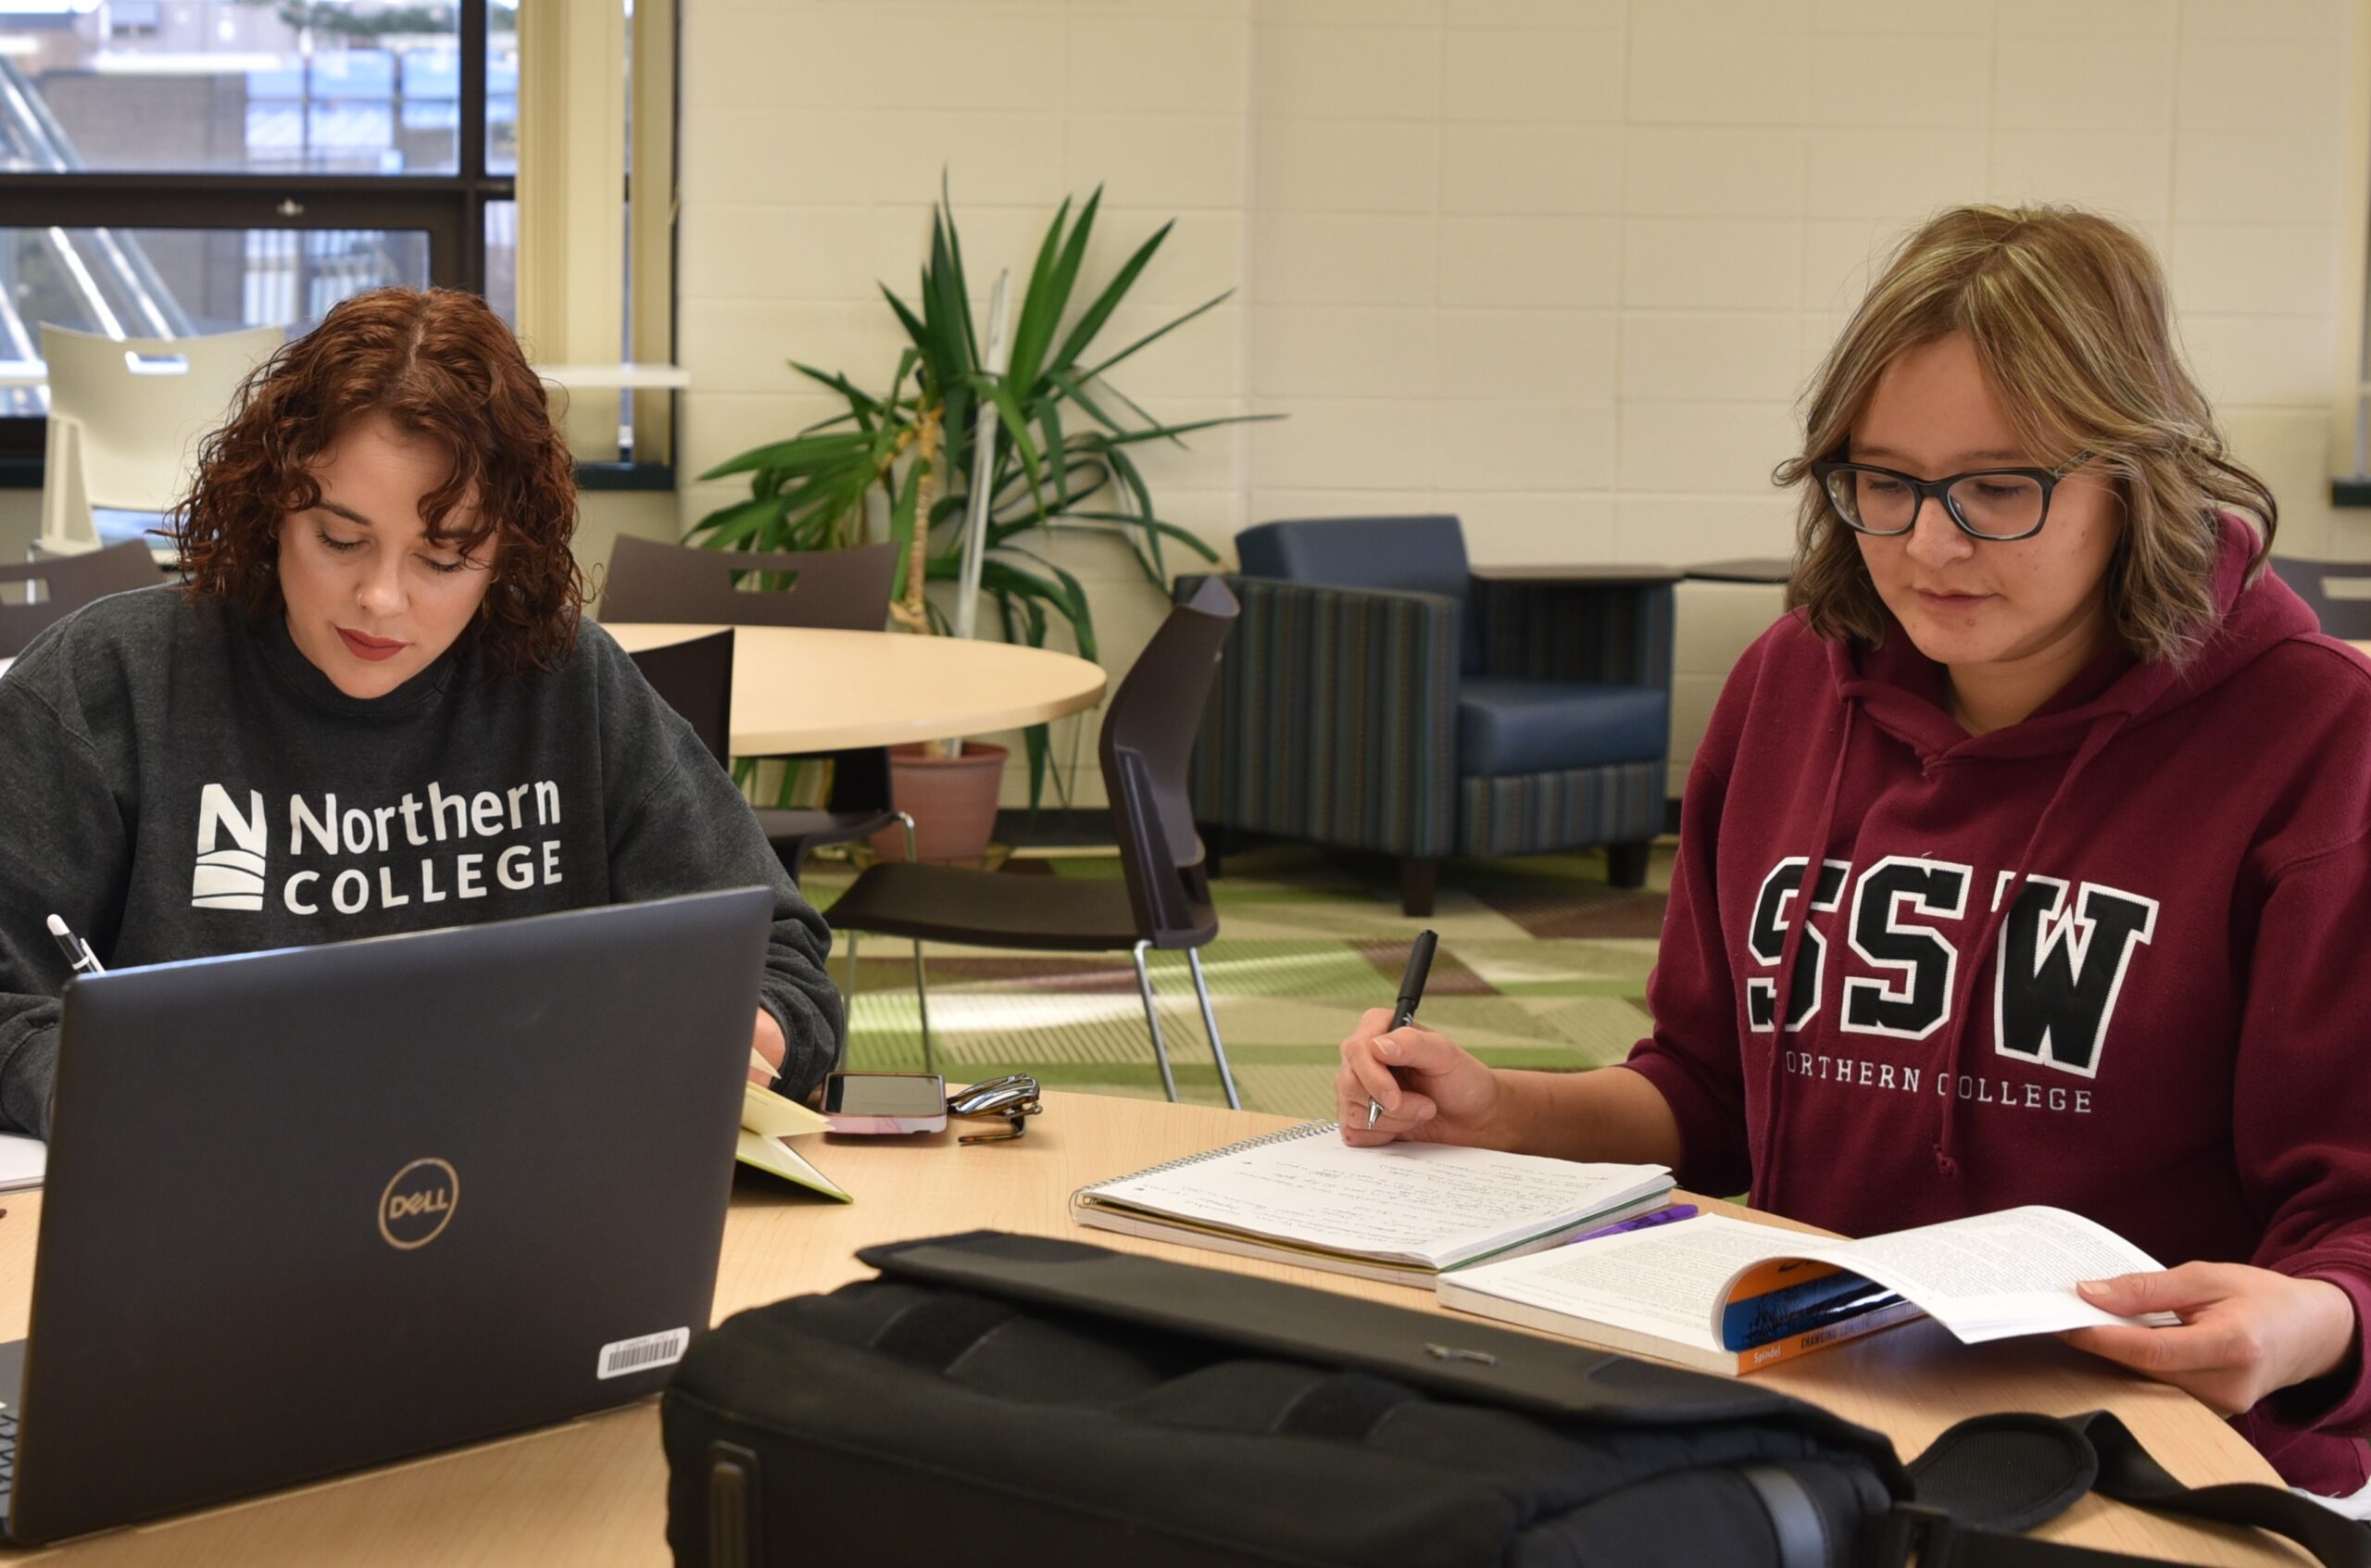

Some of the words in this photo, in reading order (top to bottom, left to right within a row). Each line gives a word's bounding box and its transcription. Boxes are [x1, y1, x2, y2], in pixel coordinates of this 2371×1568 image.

[290, 780, 560, 855] Northern
[283, 840, 562, 915] COLLEGE
[1747, 855, 2160, 1079] SSW
[1786, 1051, 1921, 1093] ORTHERN
[1938, 1073, 2092, 1113] COLLEGE
[389, 1187, 448, 1220] DELL
[1753, 1346, 1782, 1364] Spindel
